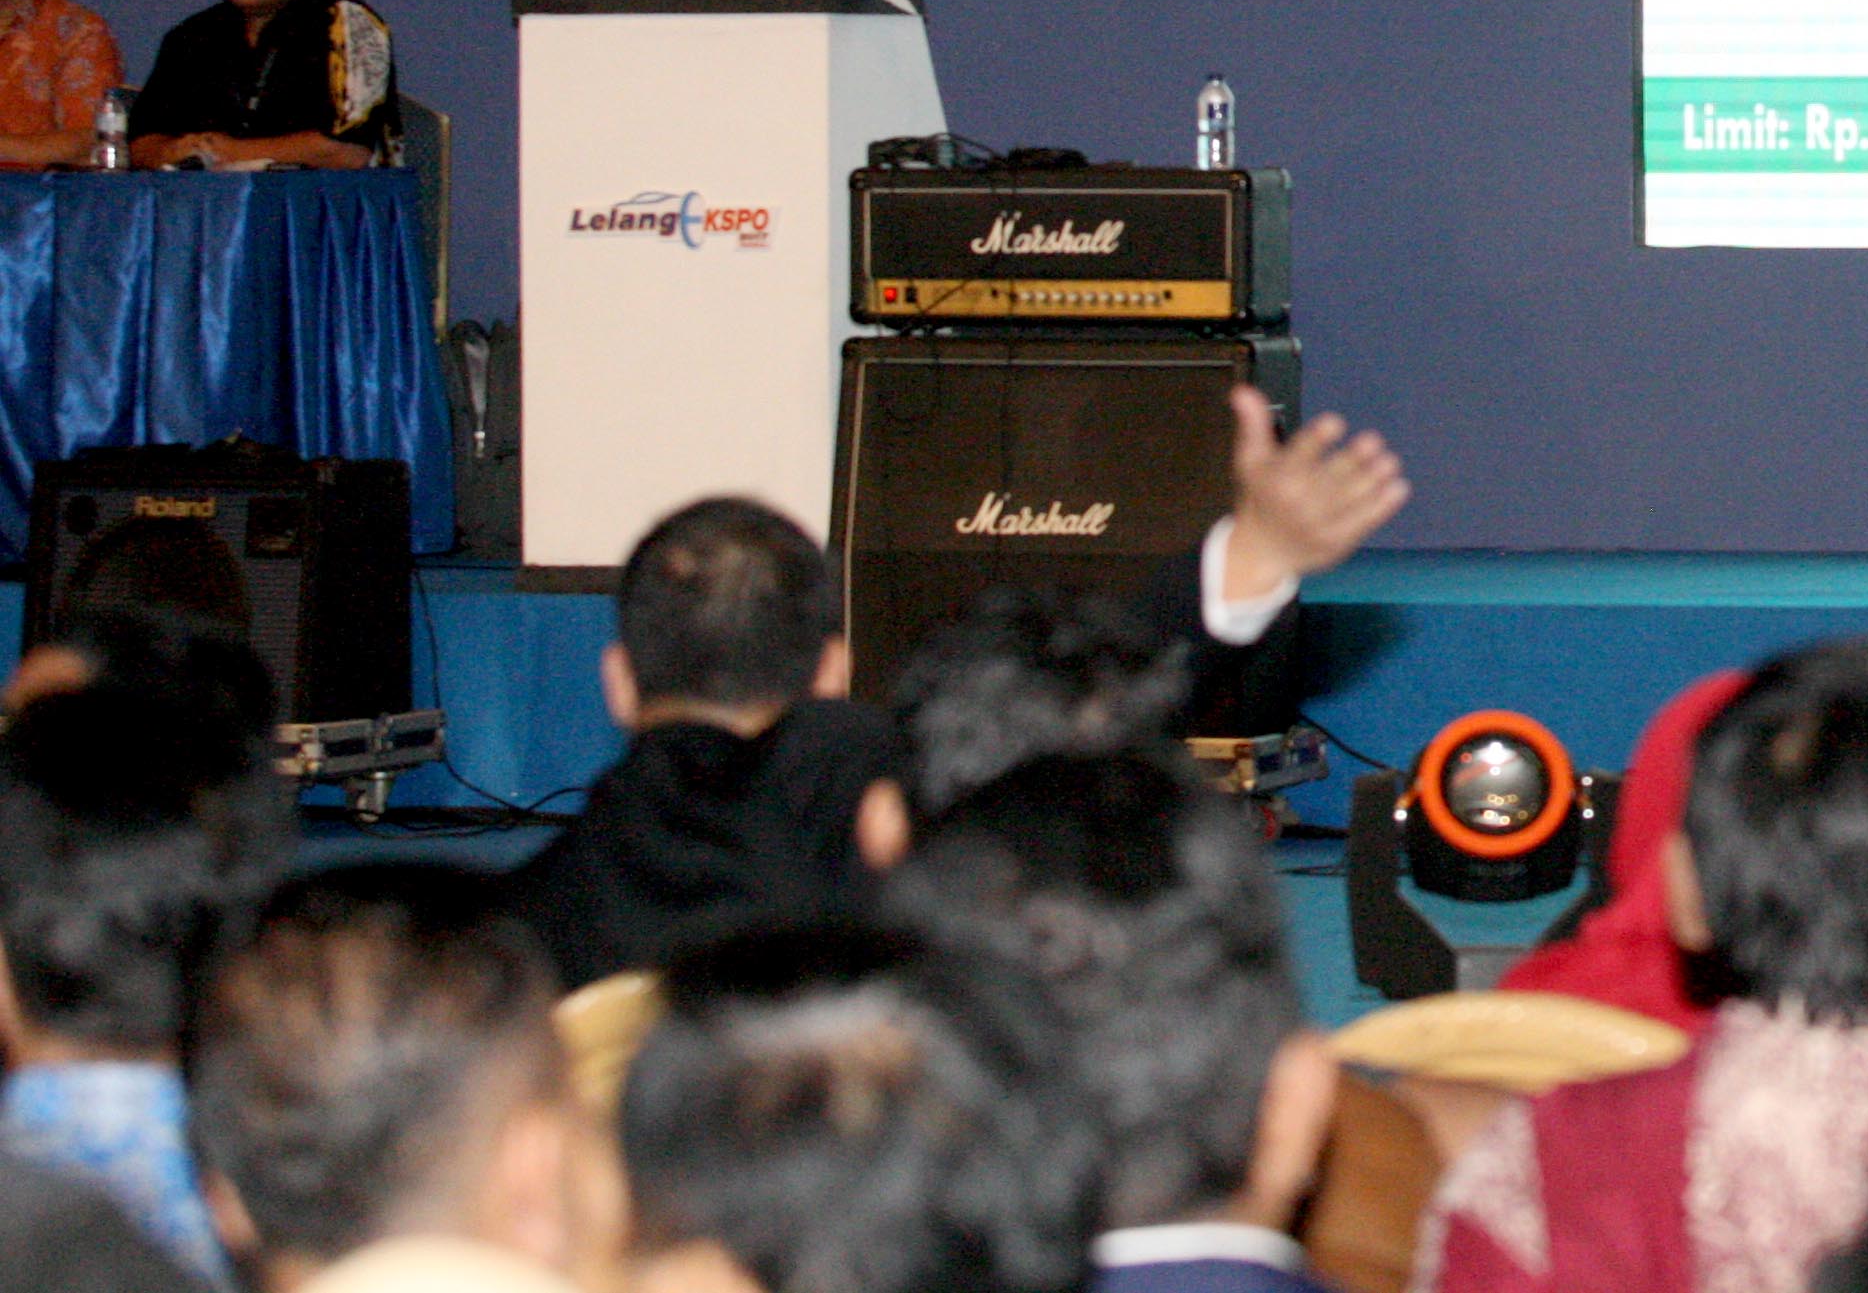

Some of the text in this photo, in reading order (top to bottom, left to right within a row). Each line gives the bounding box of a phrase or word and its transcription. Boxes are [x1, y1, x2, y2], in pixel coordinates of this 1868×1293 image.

[1683, 105, 1788, 151] Limit:
[1806, 105, 1868, 161] Rp.
[570, 209, 680, 236] Lelang
[970, 211, 1125, 254] Marshall
[134, 496, 216, 519] Roland
[956, 491, 1115, 535] Marshall
